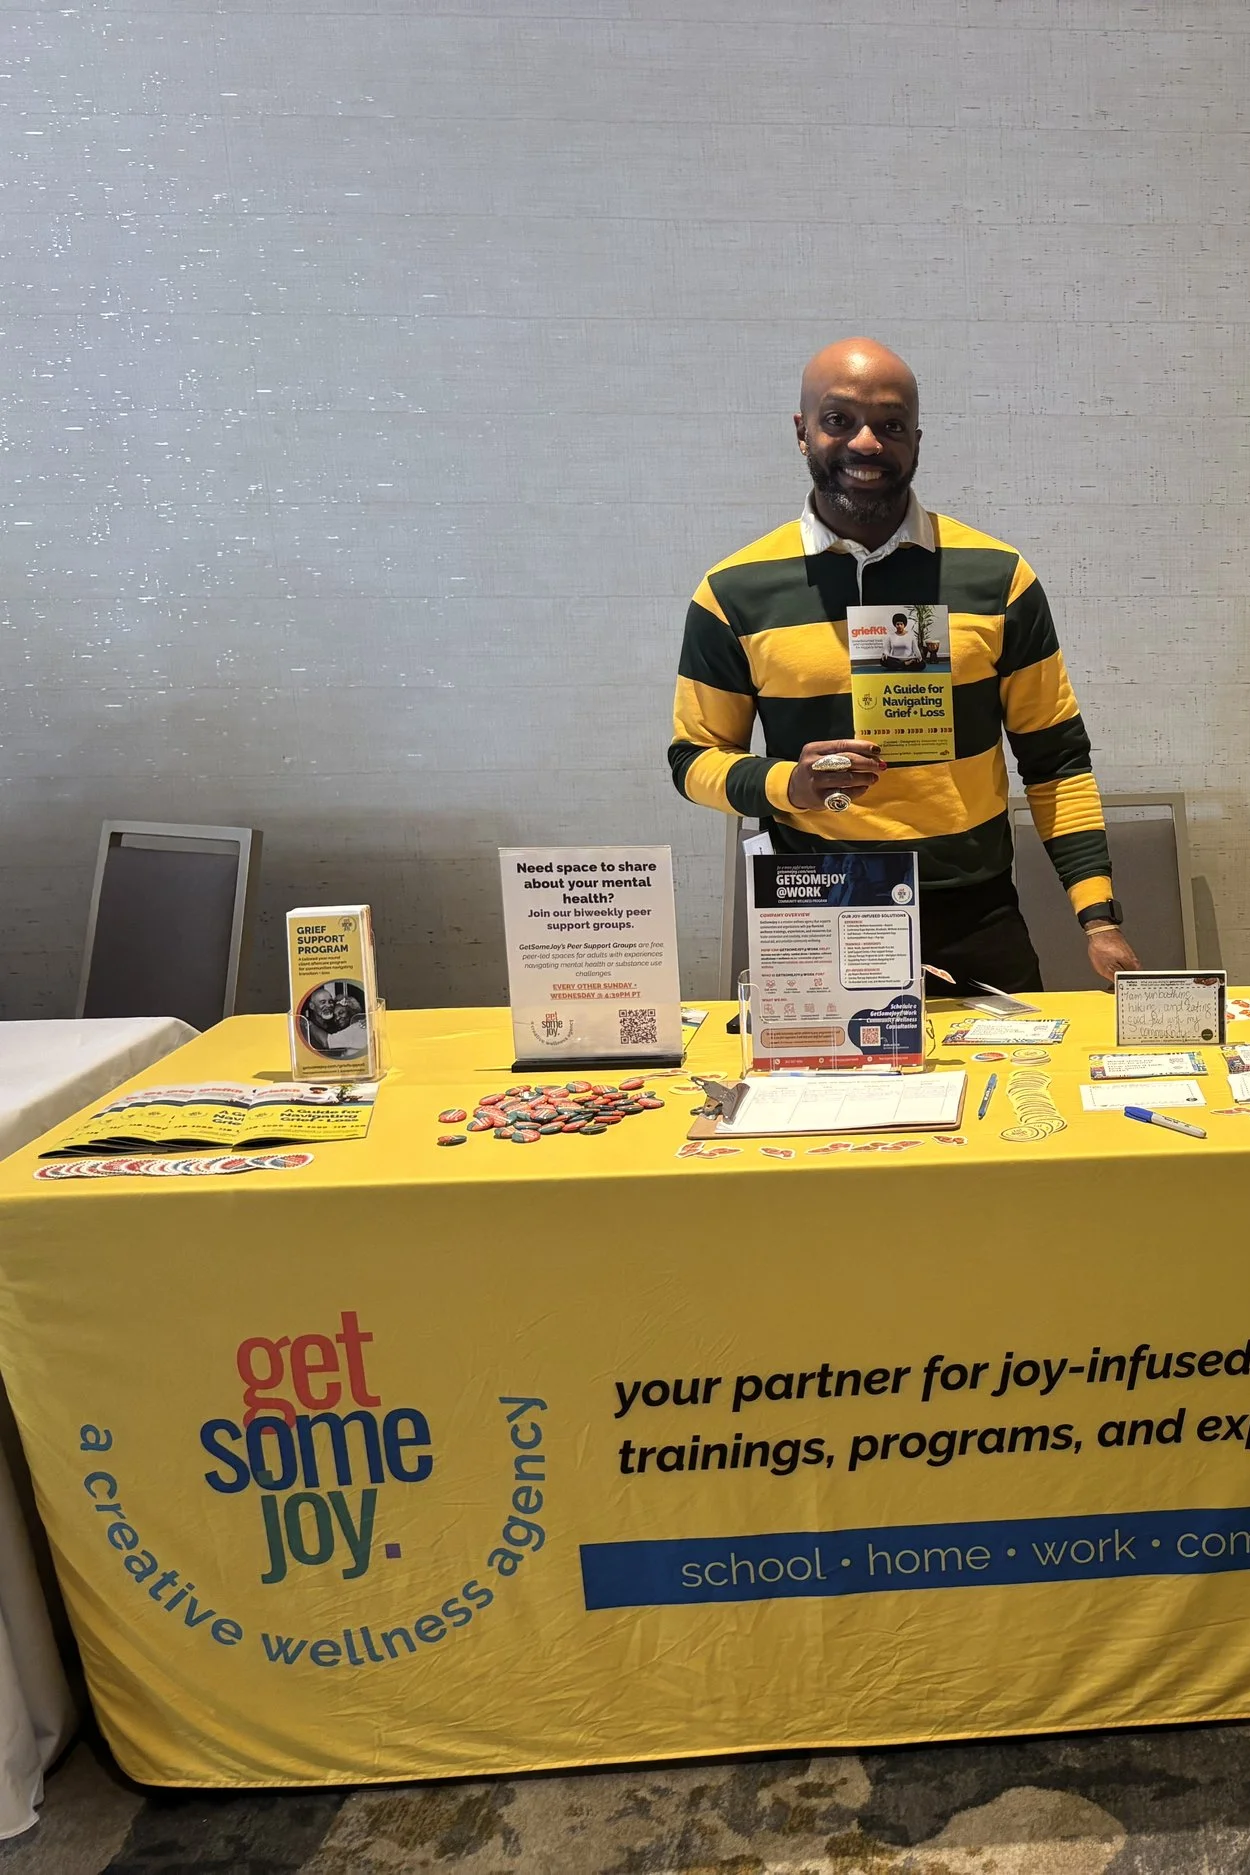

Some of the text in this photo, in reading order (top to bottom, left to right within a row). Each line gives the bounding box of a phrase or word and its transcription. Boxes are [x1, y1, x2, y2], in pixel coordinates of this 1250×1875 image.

[884, 684, 944, 694] A Guide for
[883, 696, 942, 708] Navigating
[885, 708, 945, 718] Grief Loss
[516, 861, 657, 875] Need space to share
[524, 877, 651, 890] about your mental
[776, 873, 846, 887] GETSOMEJOY
[776, 886, 821, 898] @WORK
[563, 893, 615, 904] health?
[528, 909, 550, 918] Join
[574, 908, 623, 918] biweekly
[626, 909, 651, 918] peer
[297, 926, 326, 934] GRIEF
[547, 921, 634, 931] support groups.
[297, 935, 345, 944] SUPPORT
[298, 945, 349, 954] PROGRAM
[584, 942, 611, 950] Support
[522, 952, 550, 960] peer-led
[525, 961, 559, 969] navigating
[236, 1311, 382, 1435] get
[614, 1375, 721, 1418] your
[732, 1363, 912, 1413] partner
[921, 1354, 989, 1402] for
[617, 1432, 835, 1476] trainings,
[848, 1422, 1083, 1472] programs,
[1097, 1408, 1187, 1448] and
[200, 1407, 433, 1495] some
[79, 1395, 548, 1668] a creative wellness agency
[258, 1474, 402, 1585] joy.
[681, 1547, 827, 1588] school
[867, 1543, 992, 1576] home
[1031, 1528, 1137, 1567] work
